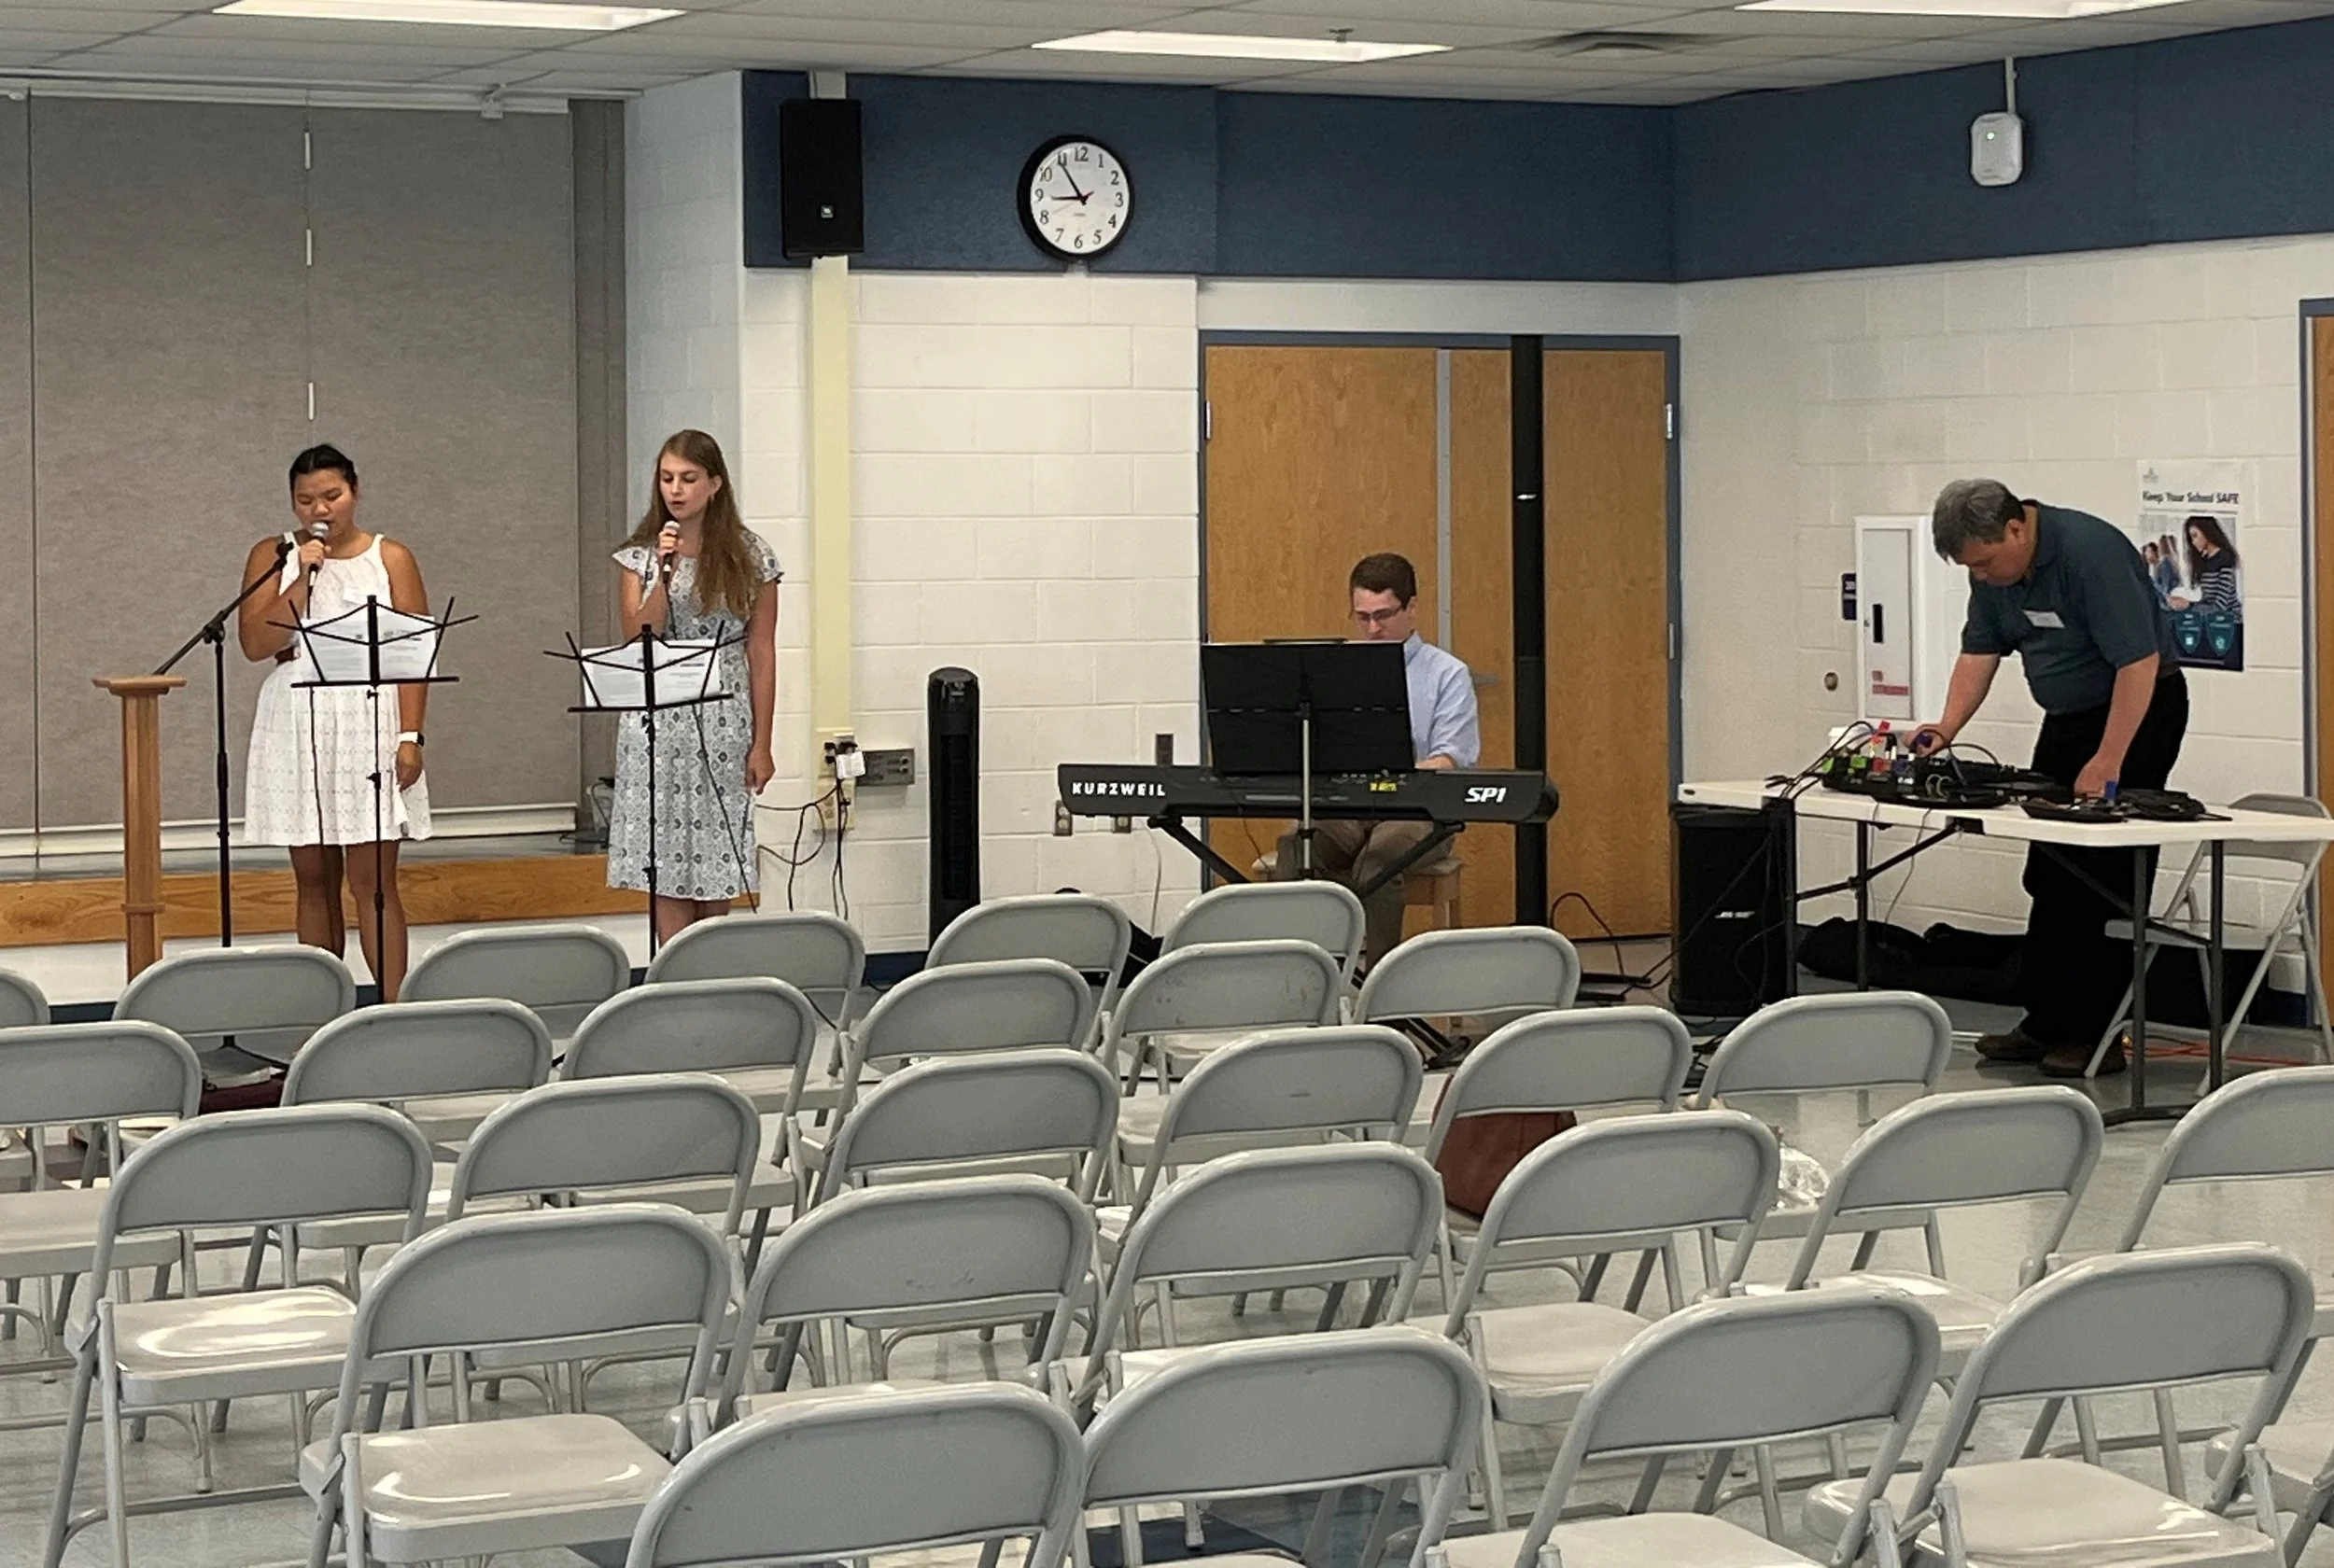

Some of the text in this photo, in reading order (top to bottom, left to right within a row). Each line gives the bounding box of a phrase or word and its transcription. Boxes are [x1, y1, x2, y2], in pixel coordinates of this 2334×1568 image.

[1075, 147, 1089, 161] 12
[1099, 154, 1104, 168] 1
[1039, 167, 1052, 182] 10
[1110, 170, 1119, 185] 2
[1034, 189, 1044, 202] 9
[1115, 192, 1124, 207] 3
[1039, 210, 1049, 225] 8
[1108, 214, 1117, 228] 4
[1055, 228, 1064, 243] 7
[1074, 234, 1083, 248] 6
[1092, 230, 1103, 245] 5
[2143, 490, 2239, 504] Keep Your School SAFE
[1072, 782, 1166, 796] KURZWEIL
